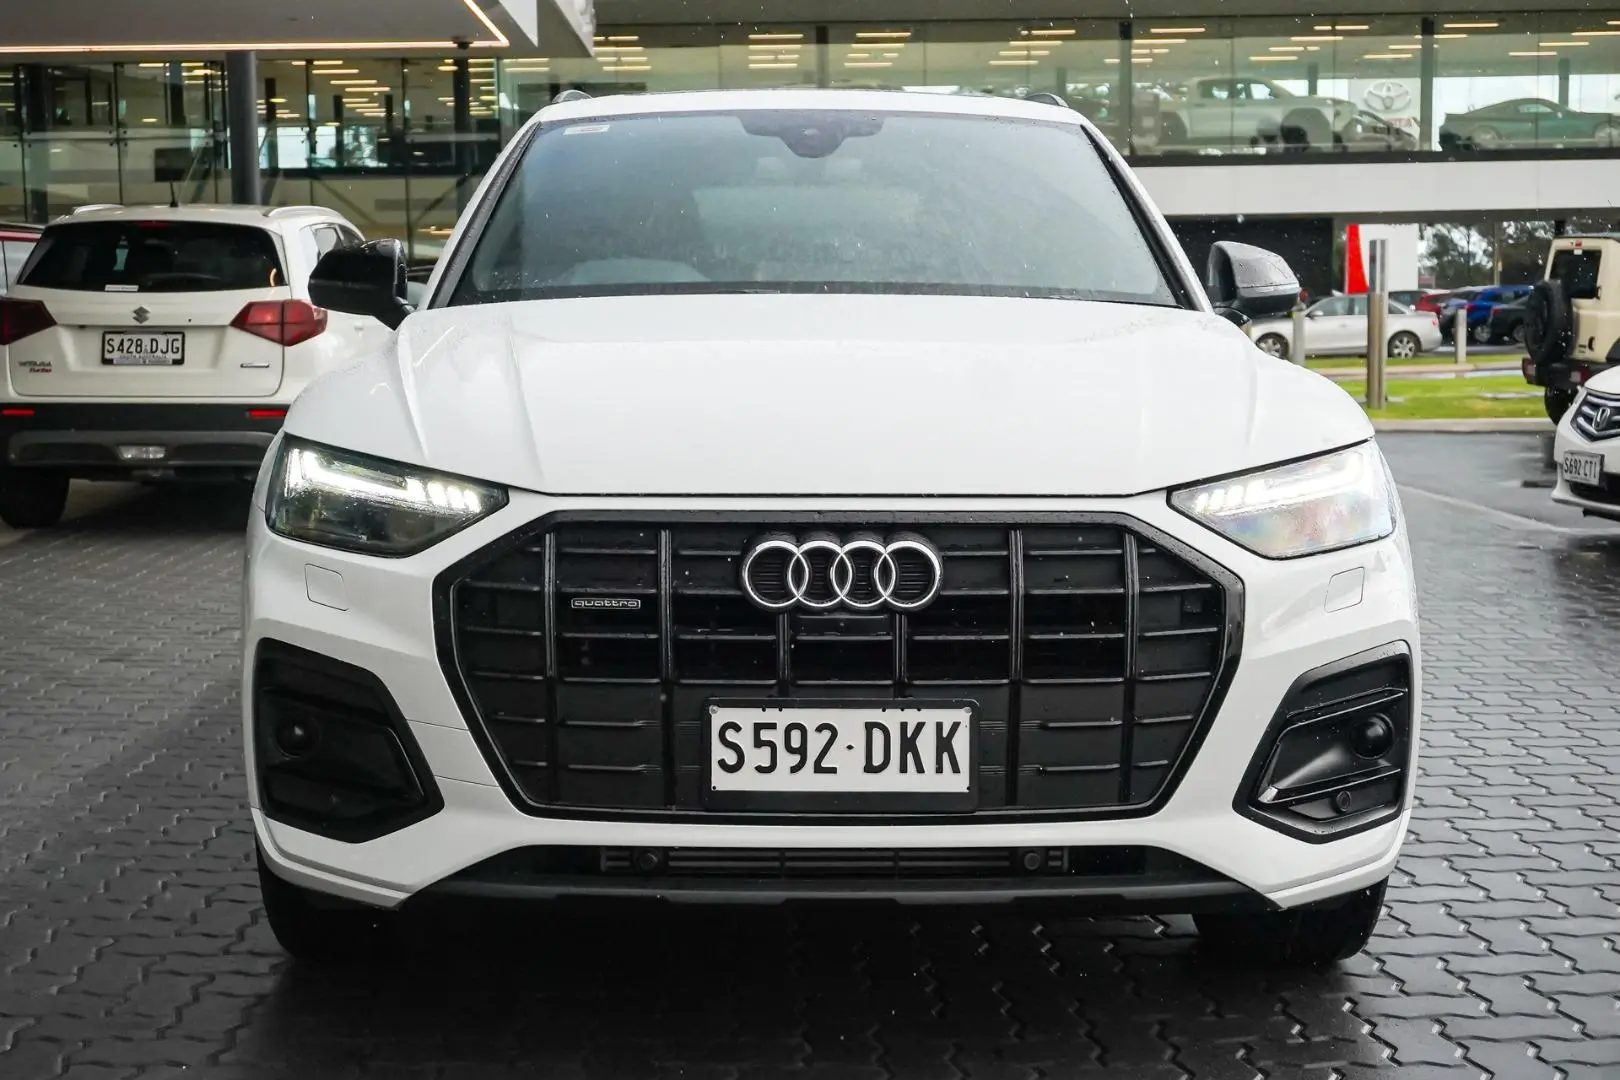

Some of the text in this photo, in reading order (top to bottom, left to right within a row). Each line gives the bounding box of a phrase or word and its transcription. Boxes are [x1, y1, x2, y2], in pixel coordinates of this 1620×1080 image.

[106, 338, 180, 354] S428 DJG
[574, 599, 638, 608] quattro
